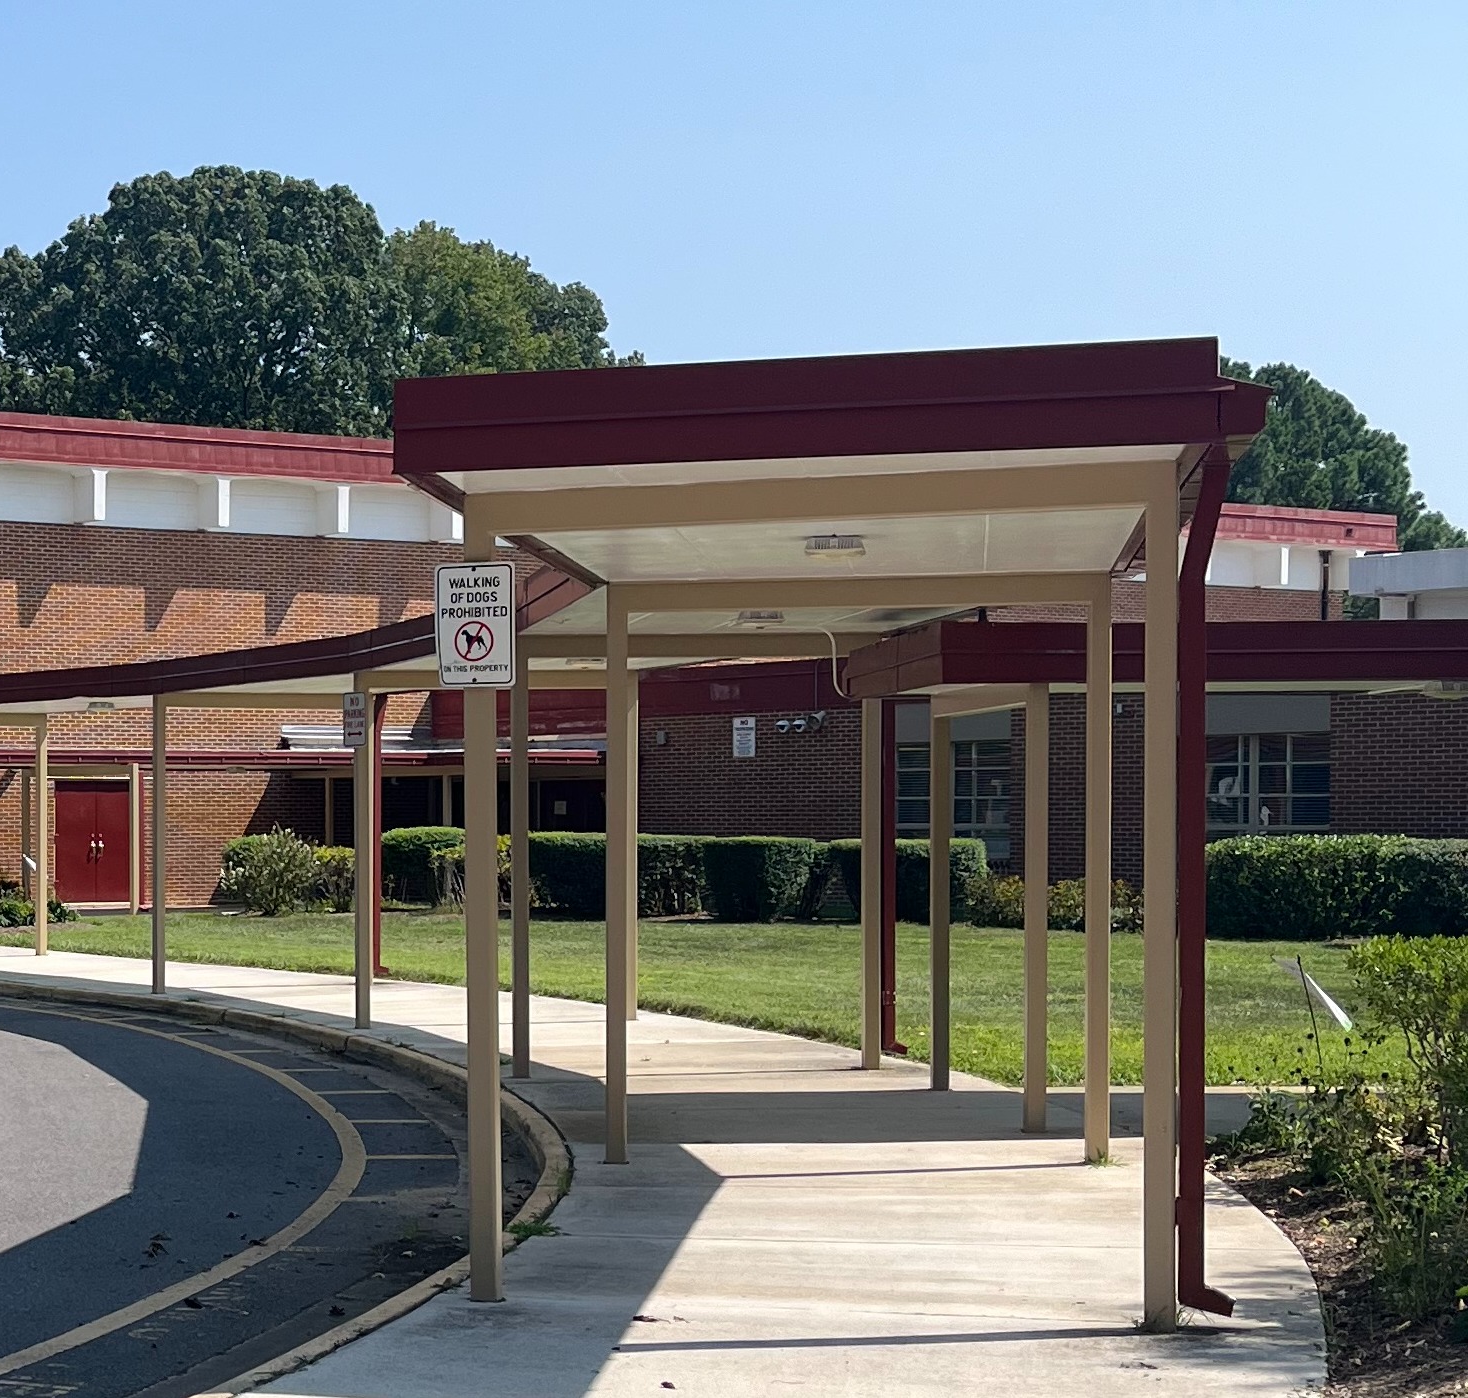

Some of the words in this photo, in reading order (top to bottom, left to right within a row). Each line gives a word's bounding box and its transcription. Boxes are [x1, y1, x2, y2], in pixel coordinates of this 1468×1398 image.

[449, 576, 500, 589] WALKING
[450, 592, 465, 604] OF
[467, 591, 498, 603] DOGS
[441, 605, 508, 619] PROHIBITED
[443, 665, 452, 673] ON
[453, 664, 468, 673] THIS
[469, 664, 509, 673] PROPERTY
[349, 696, 360, 707] NO
